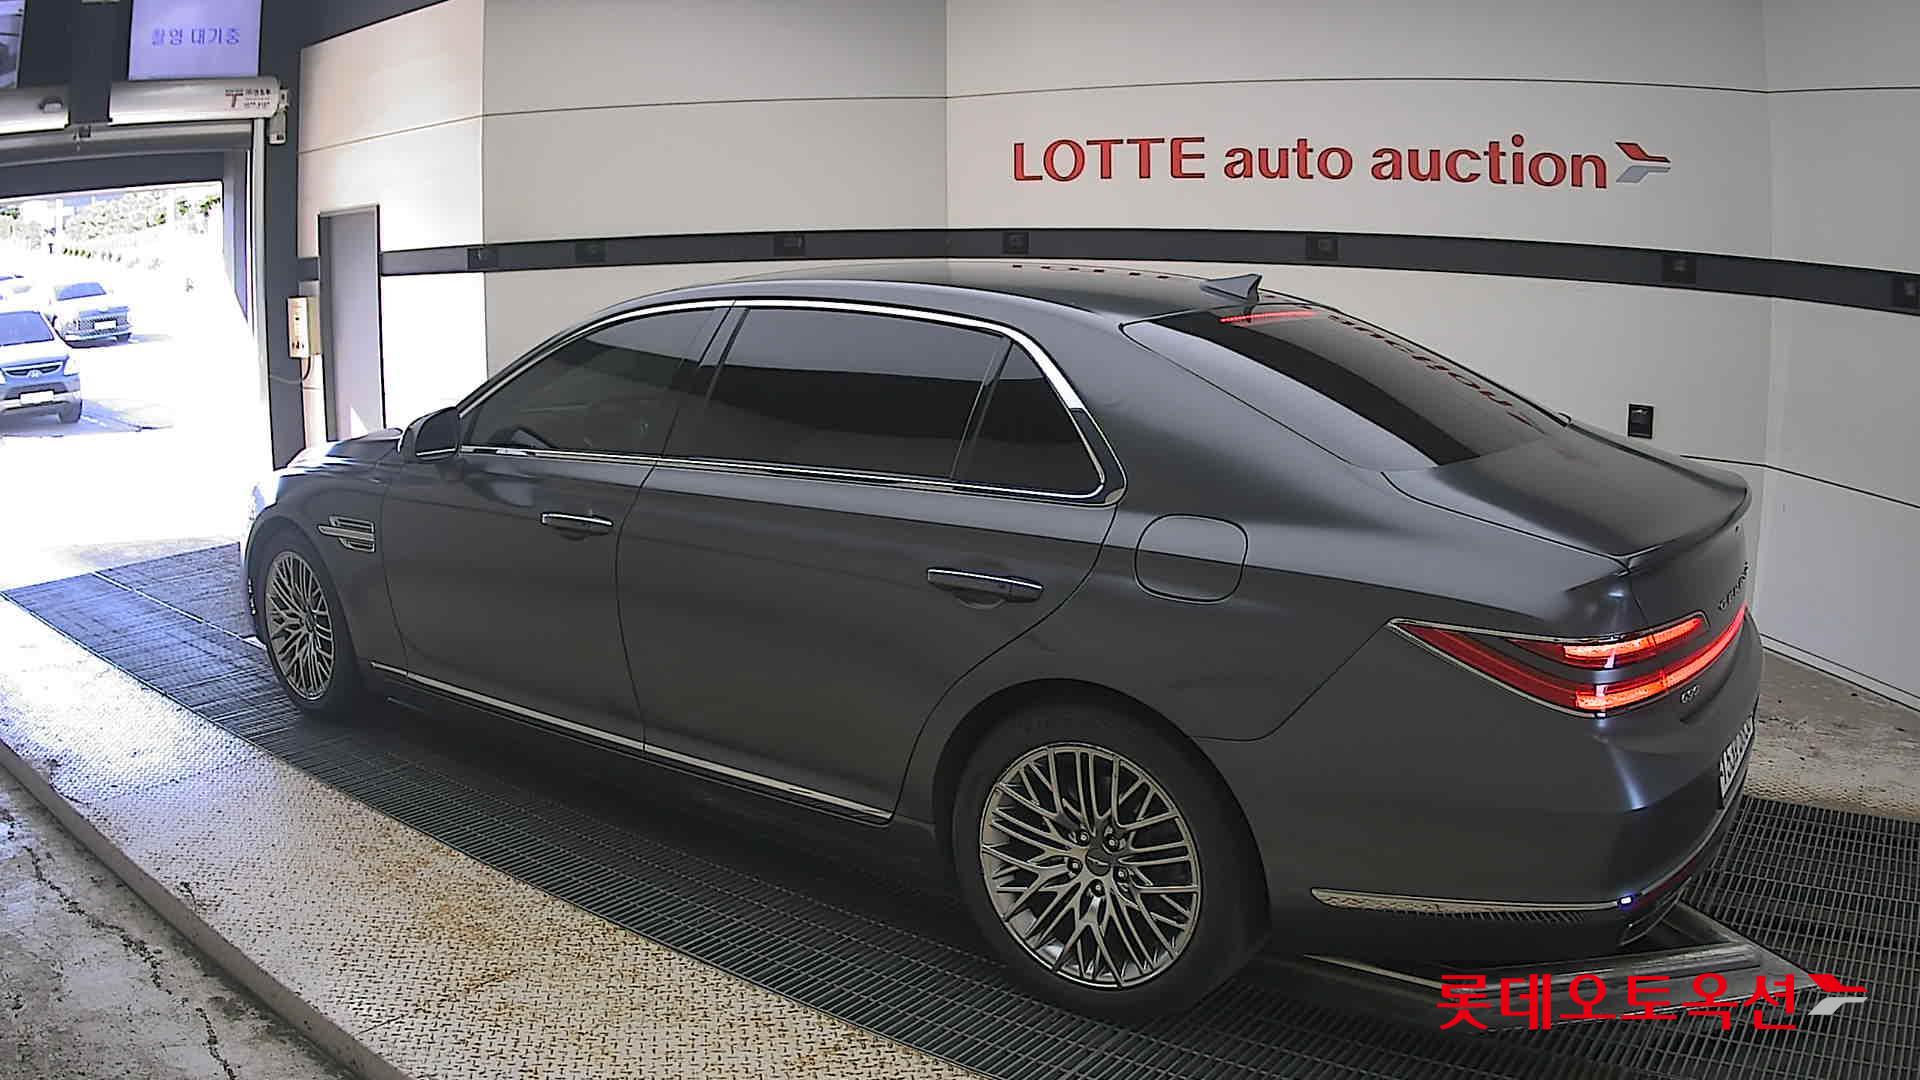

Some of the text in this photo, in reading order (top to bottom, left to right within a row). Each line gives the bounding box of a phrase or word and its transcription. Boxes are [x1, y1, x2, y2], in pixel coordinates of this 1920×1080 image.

[1012, 135, 1608, 188] LOTTE auto auction
